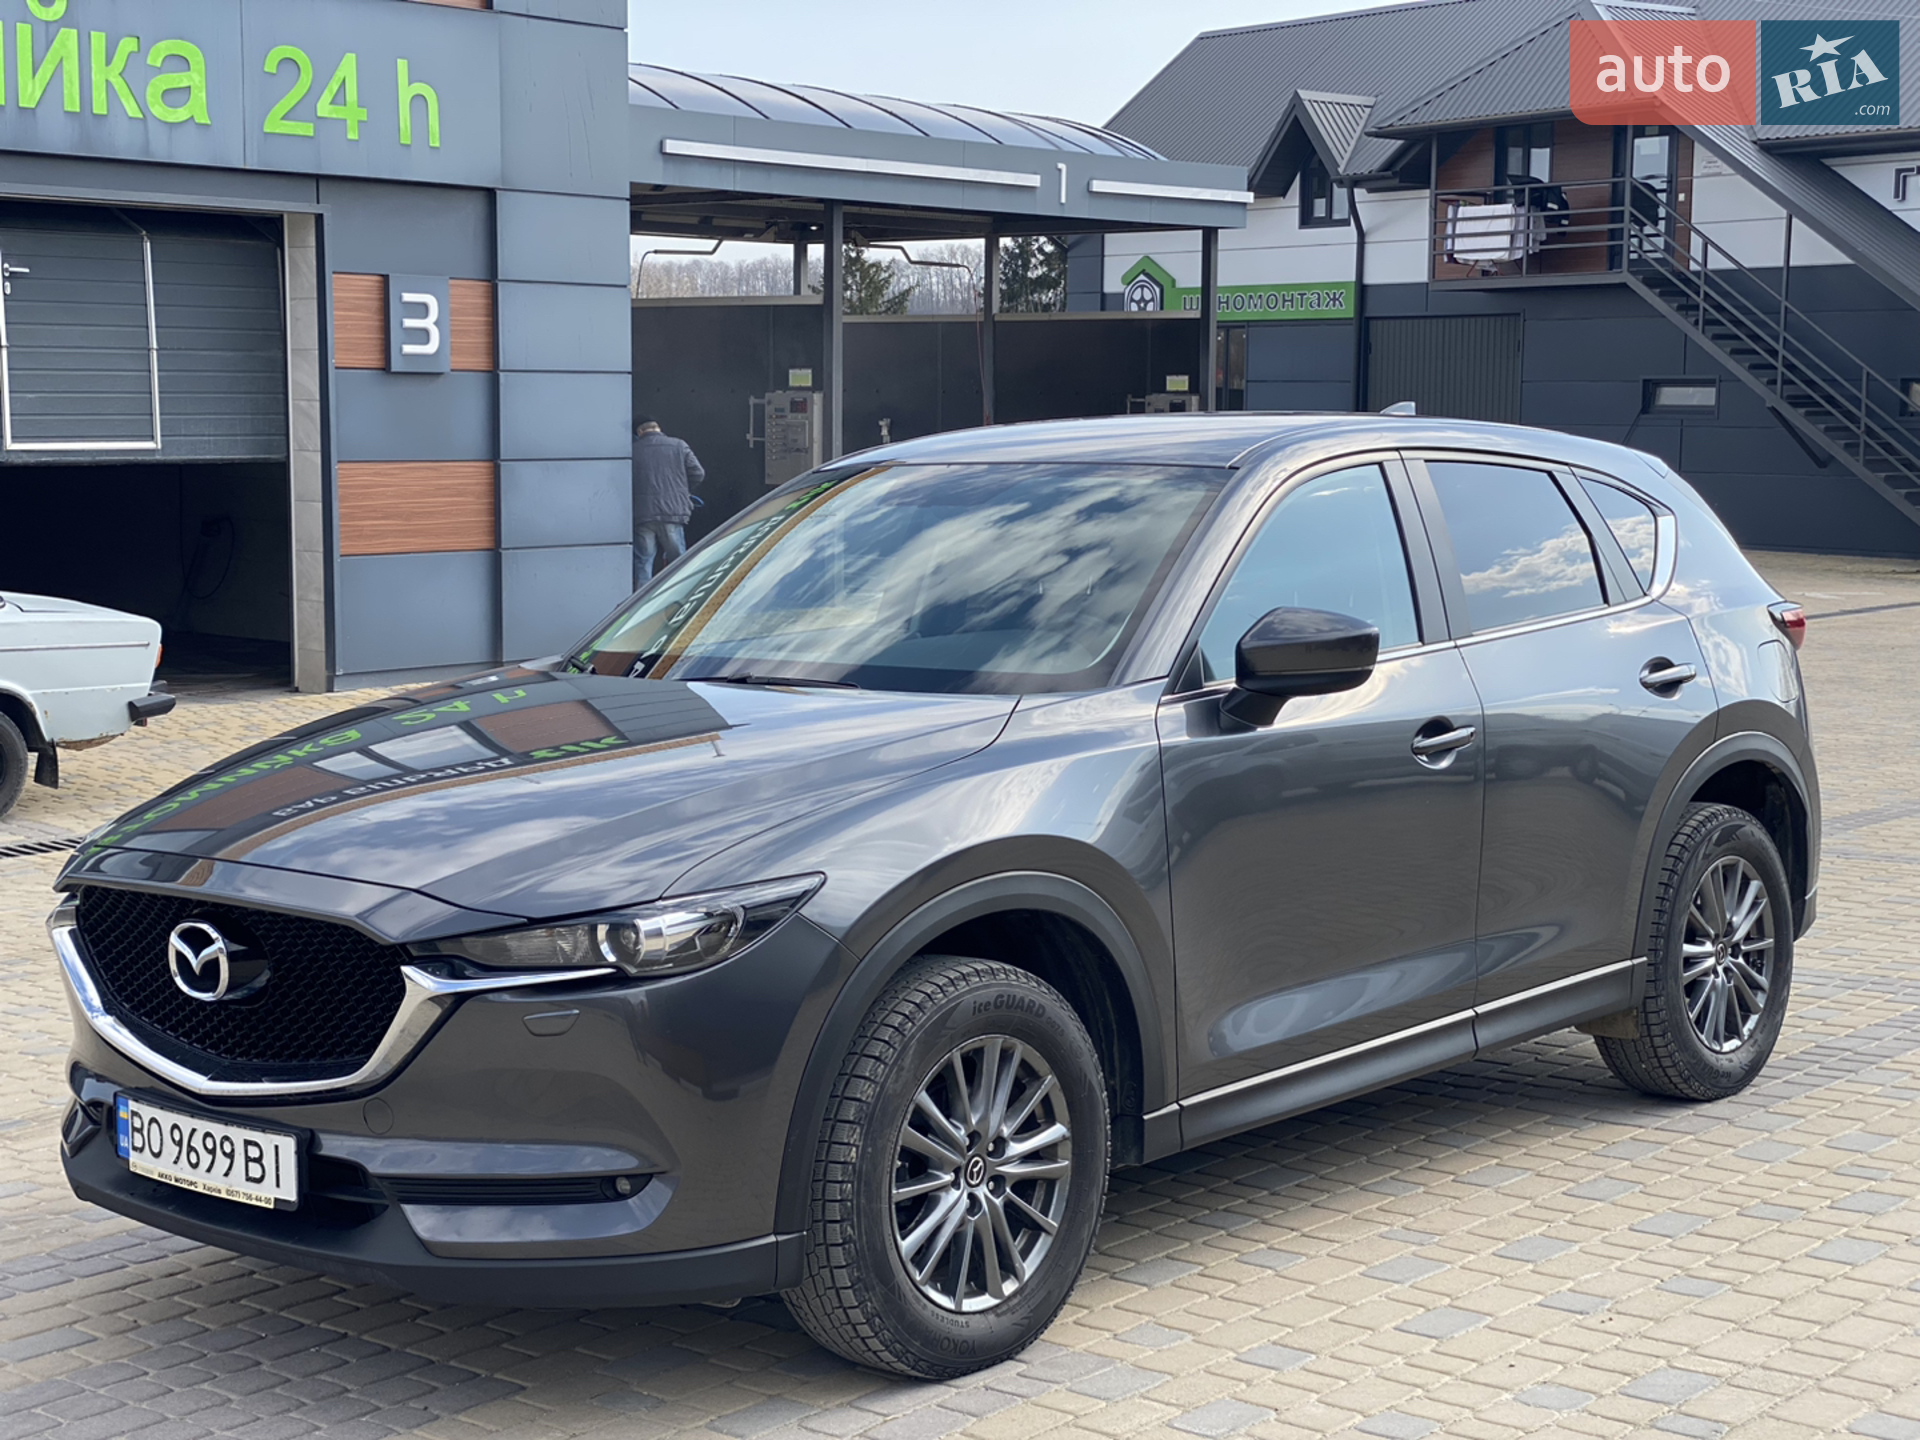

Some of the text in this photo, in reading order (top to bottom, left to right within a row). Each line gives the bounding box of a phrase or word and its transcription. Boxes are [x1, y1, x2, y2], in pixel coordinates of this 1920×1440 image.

[0, 0, 441, 148] йка 24 h
[1056, 162, 1067, 204] 1
[401, 292, 440, 355] 3
[1182, 289, 1346, 312] шномонтаж
[971, 993, 1047, 1019] iceGUARD
[169, 1123, 236, 1178] 9699
